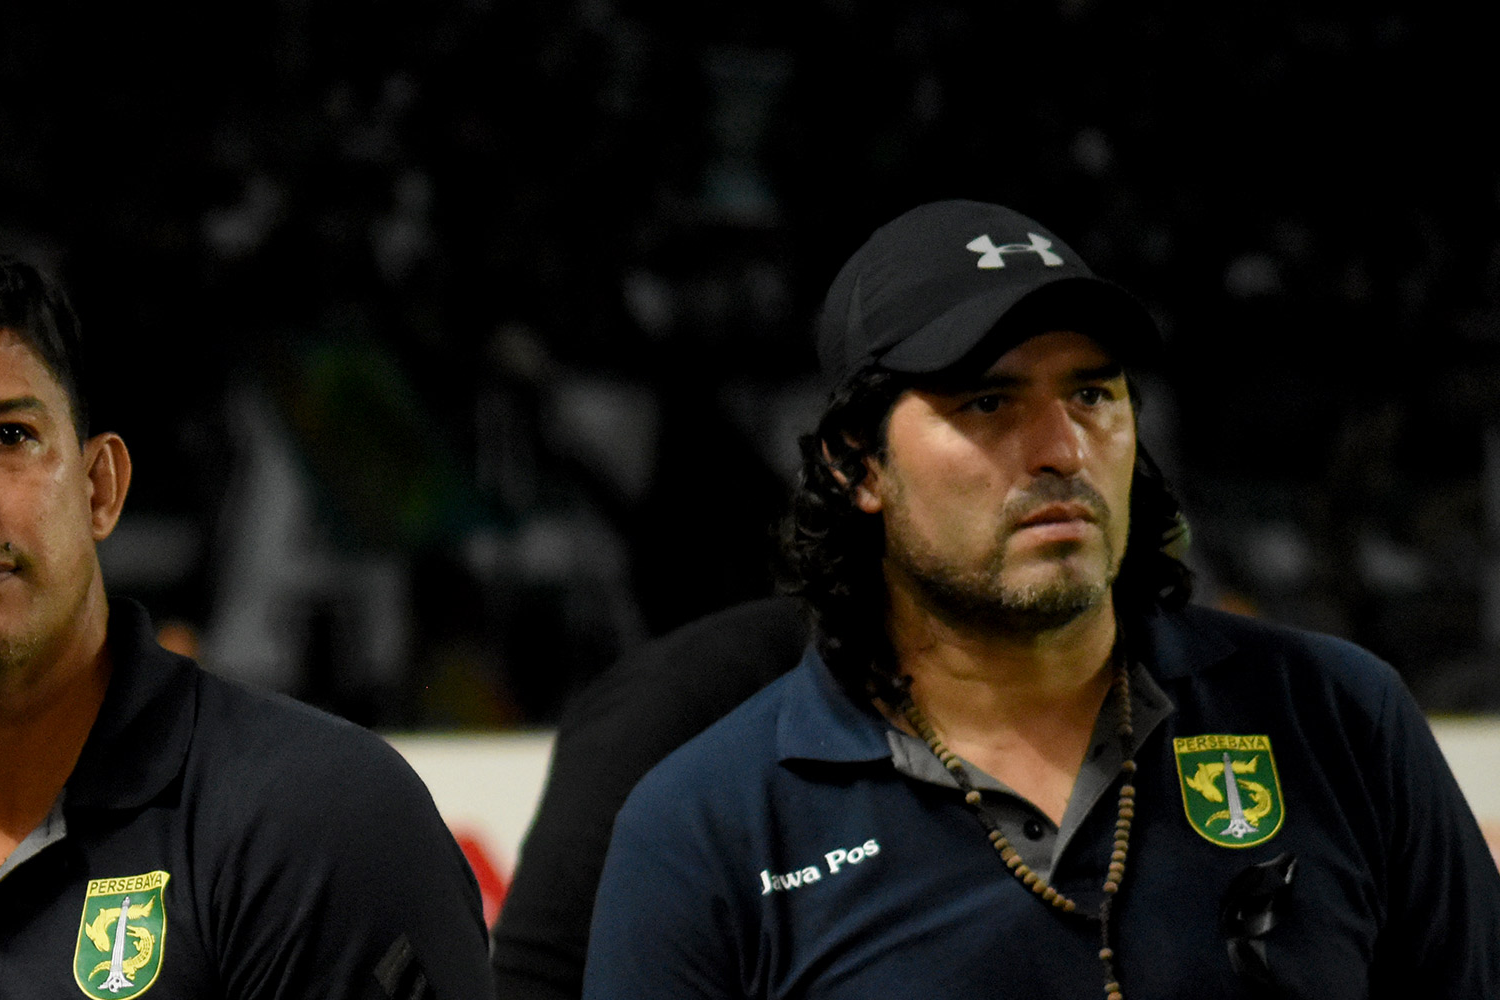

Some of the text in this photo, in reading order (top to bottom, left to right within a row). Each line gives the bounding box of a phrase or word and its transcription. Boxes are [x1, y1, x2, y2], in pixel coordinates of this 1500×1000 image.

[1176, 735, 1266, 751] PERSEBAYA
[760, 839, 880, 895] Jawa Pos
[89, 872, 163, 894] PERSEBAYA
